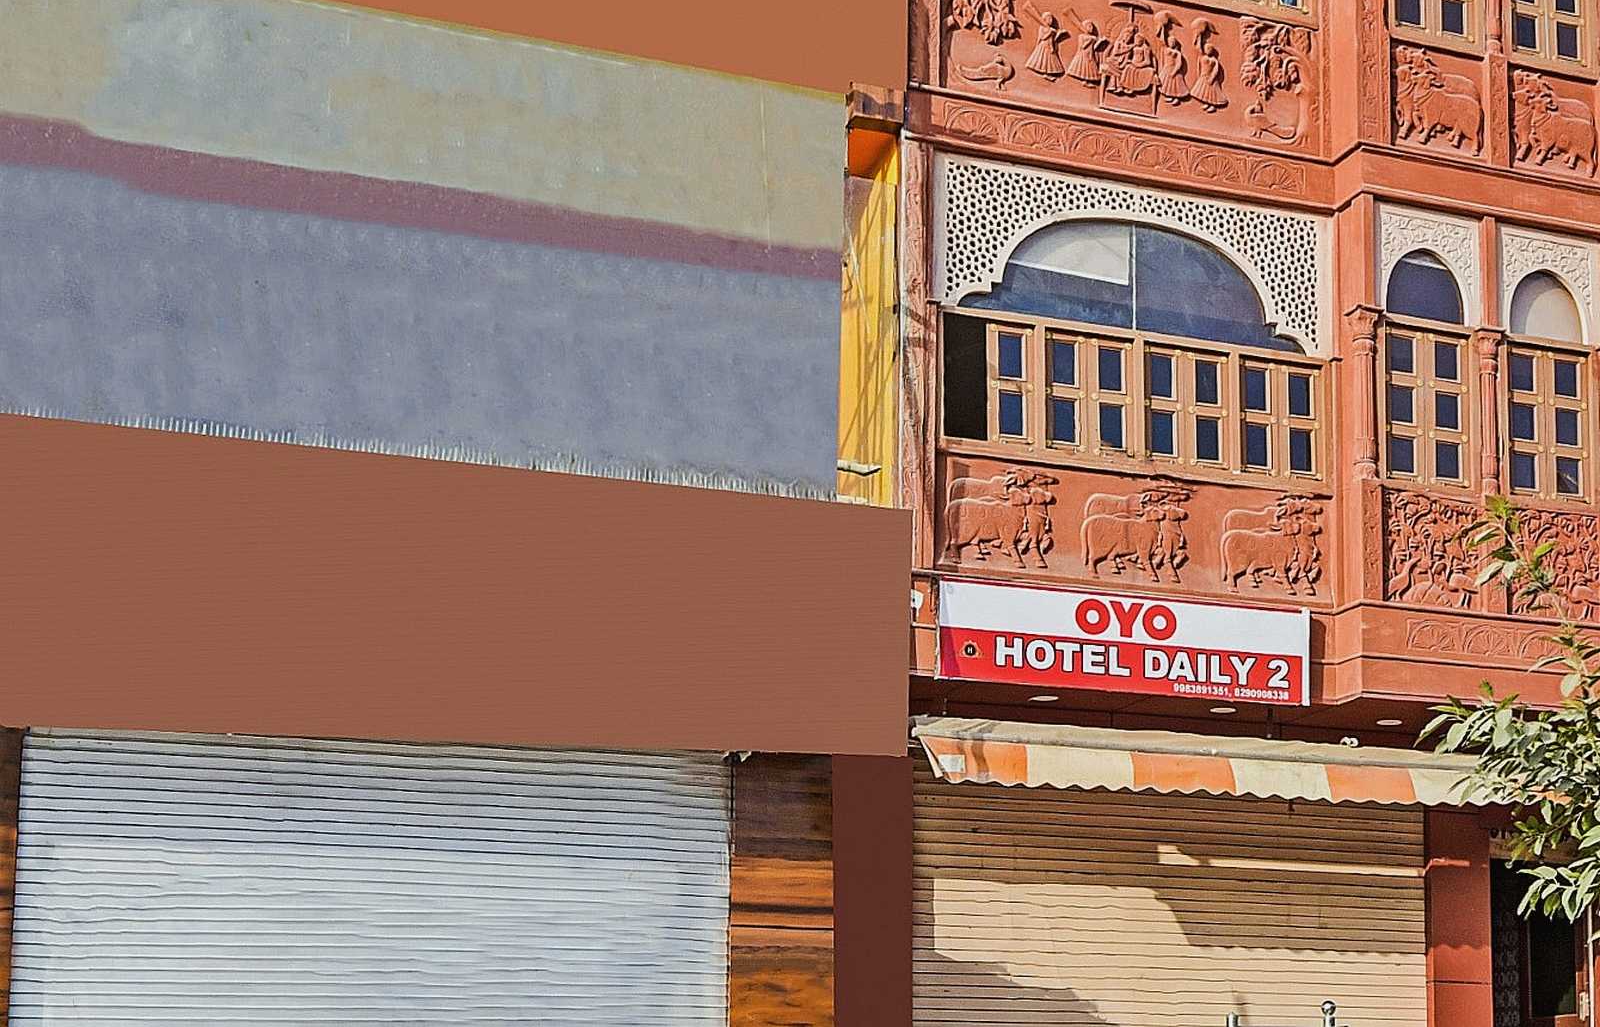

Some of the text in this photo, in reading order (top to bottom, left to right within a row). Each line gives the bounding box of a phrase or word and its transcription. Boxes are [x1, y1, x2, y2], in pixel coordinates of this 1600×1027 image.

[1075, 598, 1177, 641] OYO
[995, 636, 1291, 689] HOTEL DAILY 2
